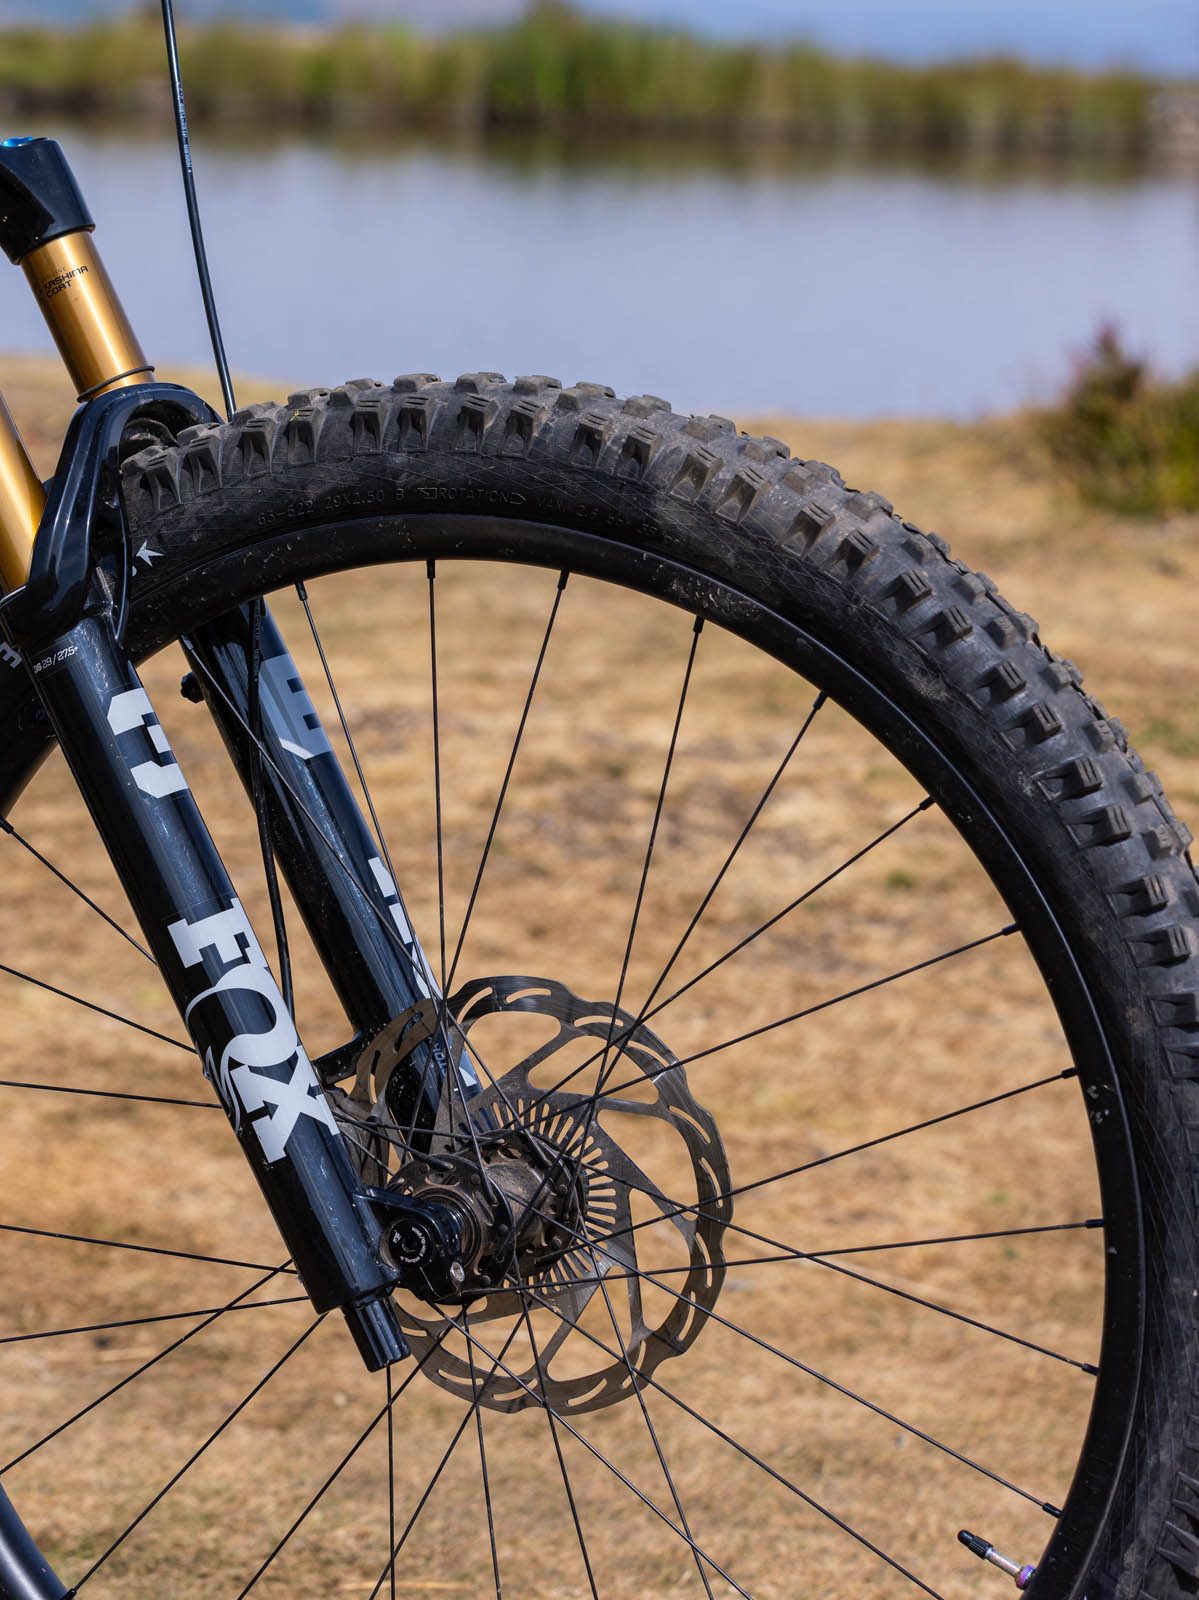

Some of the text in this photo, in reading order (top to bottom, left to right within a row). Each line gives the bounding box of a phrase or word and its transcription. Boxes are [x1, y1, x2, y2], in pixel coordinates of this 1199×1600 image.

[46, 265, 89, 290] KASHIMA
[47, 280, 72, 298] COAT
[167, 898, 341, 1164] FOX
